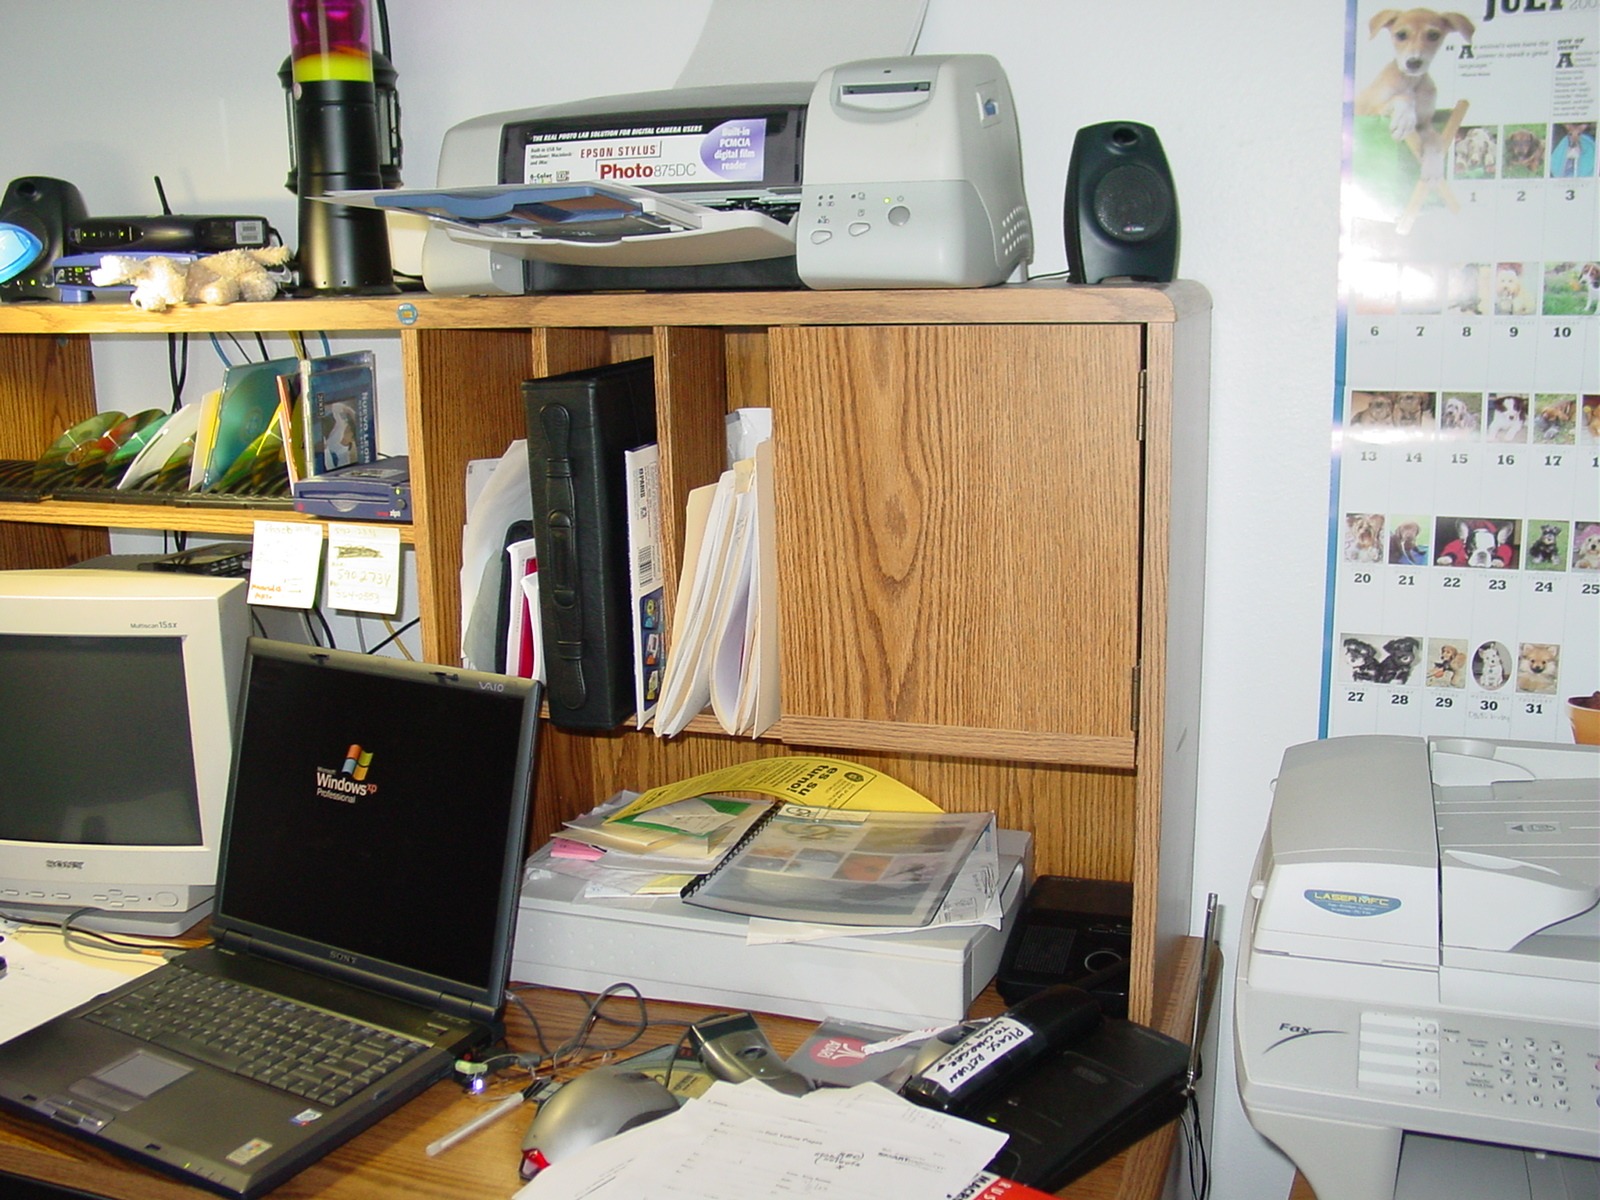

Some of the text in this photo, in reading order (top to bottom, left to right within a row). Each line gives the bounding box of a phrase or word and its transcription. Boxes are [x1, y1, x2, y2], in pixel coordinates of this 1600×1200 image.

[1556, 52, 1574, 69] A
[559, 132, 577, 140] PHOTO
[578, 131, 590, 139] LAB
[591, 129, 618, 138] SOLUTION
[619, 128, 631, 136] FOR
[632, 127, 654, 135] DIGITAL
[656, 125, 681, 134] CAMERA
[682, 125, 703, 133] USERS
[720, 138, 751, 147] PCMCIA
[580, 144, 656, 158] EPSON STYLUS
[714, 148, 756, 161] digital film
[721, 160, 747, 170] reader
[1470, 192, 1477, 202] 1
[1517, 191, 1526, 201] 2
[1565, 190, 1575, 201] 3
[1370, 327, 1379, 337] 6
[1416, 327, 1425, 337] 7
[1462, 327, 1472, 337] 8
[1509, 327, 1519, 338] 9
[1553, 327, 1572, 338] 10
[1360, 451, 1377, 462] 13
[1405, 452, 1423, 463] 14
[1451, 454, 1468, 464] 15
[1498, 455, 1515, 466] 16
[1544, 455, 1562, 466] 17
[1354, 573, 1371, 584] 20
[1398, 575, 1415, 586] 21
[1443, 577, 1461, 588] 22
[1488, 580, 1507, 590] 23
[1534, 582, 1553, 592] 24
[1581, 584, 1600, 595] 25
[478, 681, 505, 692] VAIO
[1347, 692, 1365, 702] 27
[1391, 694, 1409, 705] 28
[1435, 697, 1453, 708] 29
[1479, 700, 1498, 711] 30
[1525, 703, 1543, 714] 31
[316, 772, 367, 796] Windows
[786, 765, 829, 795] turno!
[797, 766, 839, 796] es su
[316, 788, 357, 804] Professional
[330, 951, 357, 964] SONY
[1279, 1023, 1312, 1034] Fax
